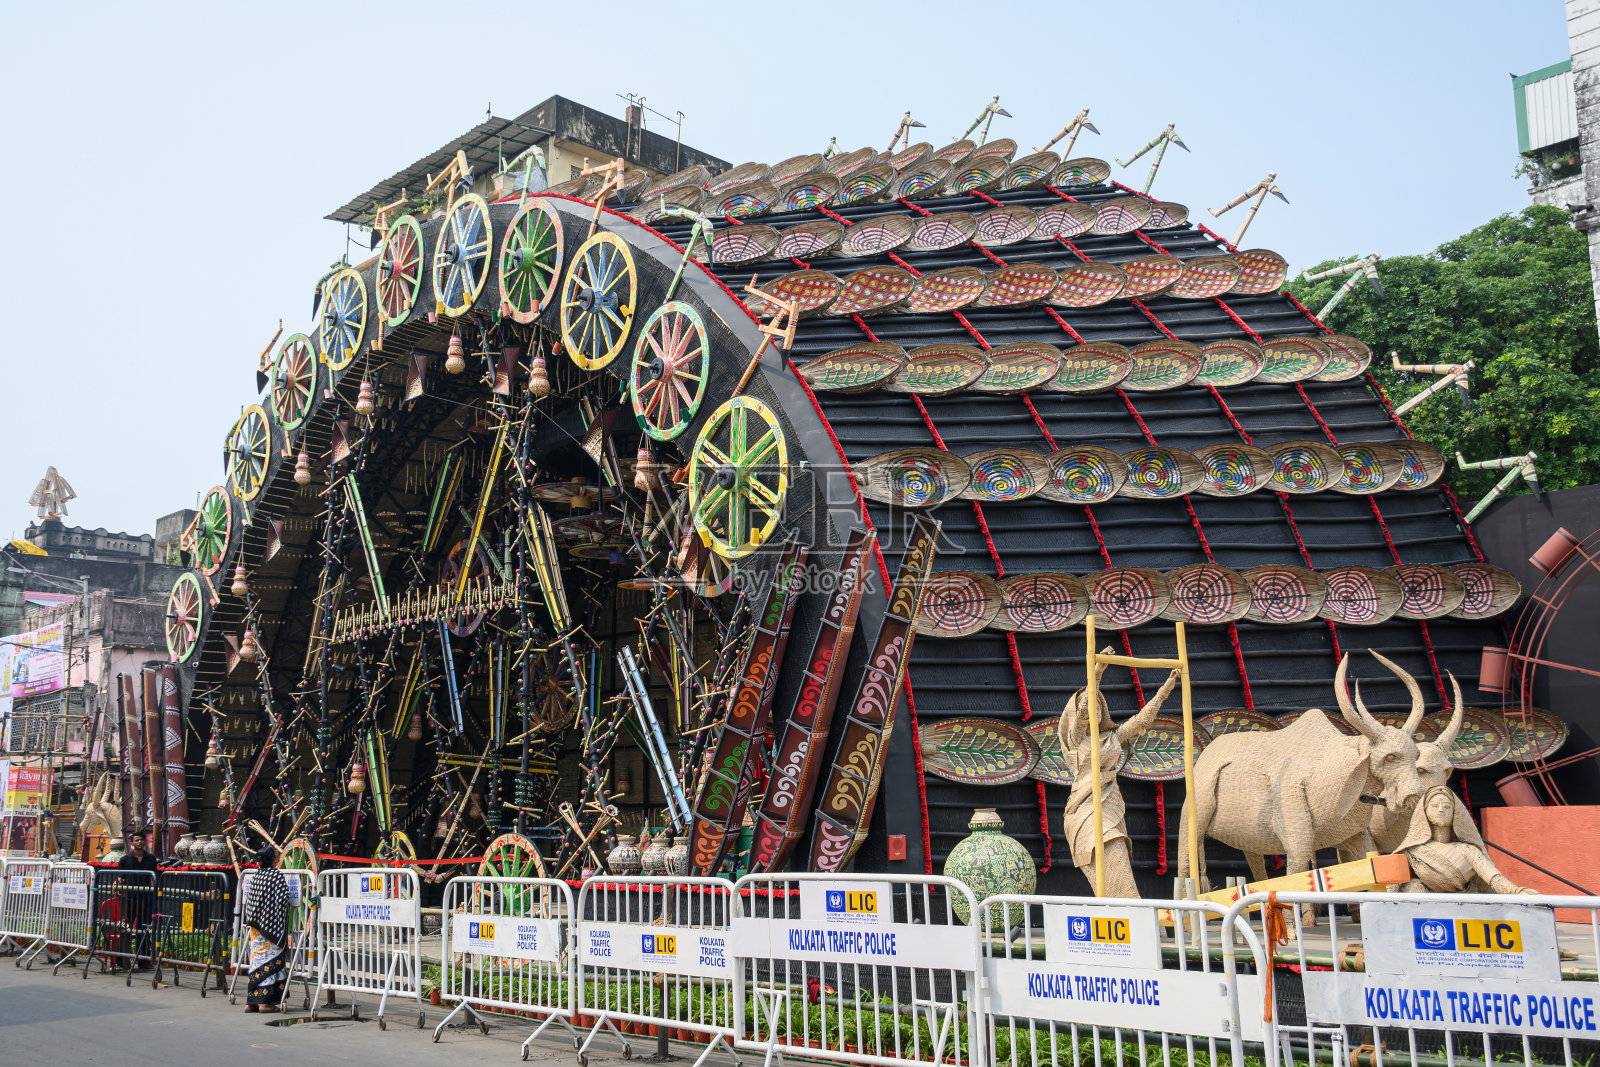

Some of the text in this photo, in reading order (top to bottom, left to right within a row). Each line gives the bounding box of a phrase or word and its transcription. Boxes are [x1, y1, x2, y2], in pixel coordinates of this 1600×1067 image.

[370, 878, 381, 890] LIC
[849, 893, 874, 911] LIC
[345, 904, 391, 921] KOLKATA TRAFFIC POLICE
[481, 925, 494, 938] LIC
[517, 925, 537, 933] KOLKATA
[589, 930, 610, 938] KOLKATA
[1095, 919, 1126, 941] LIC
[518, 933, 537, 942] TRAFFIC
[699, 936, 725, 948] KOLKATA
[788, 929, 897, 956] KOLKATA TRAFFIC POLICE
[1461, 923, 1515, 950] LIC
[517, 941, 537, 951] POLICE
[591, 939, 610, 947] TRAFFIC
[657, 937, 674, 953] LIC
[590, 947, 611, 957] POLICE
[701, 946, 724, 958] TRAFFIC
[699, 956, 726, 968] POLICE
[1028, 973, 1160, 1006] KOLKATA TRAFFIC POLICE
[1364, 987, 1597, 1031] KOLKATA TRAFFIC POLICE
